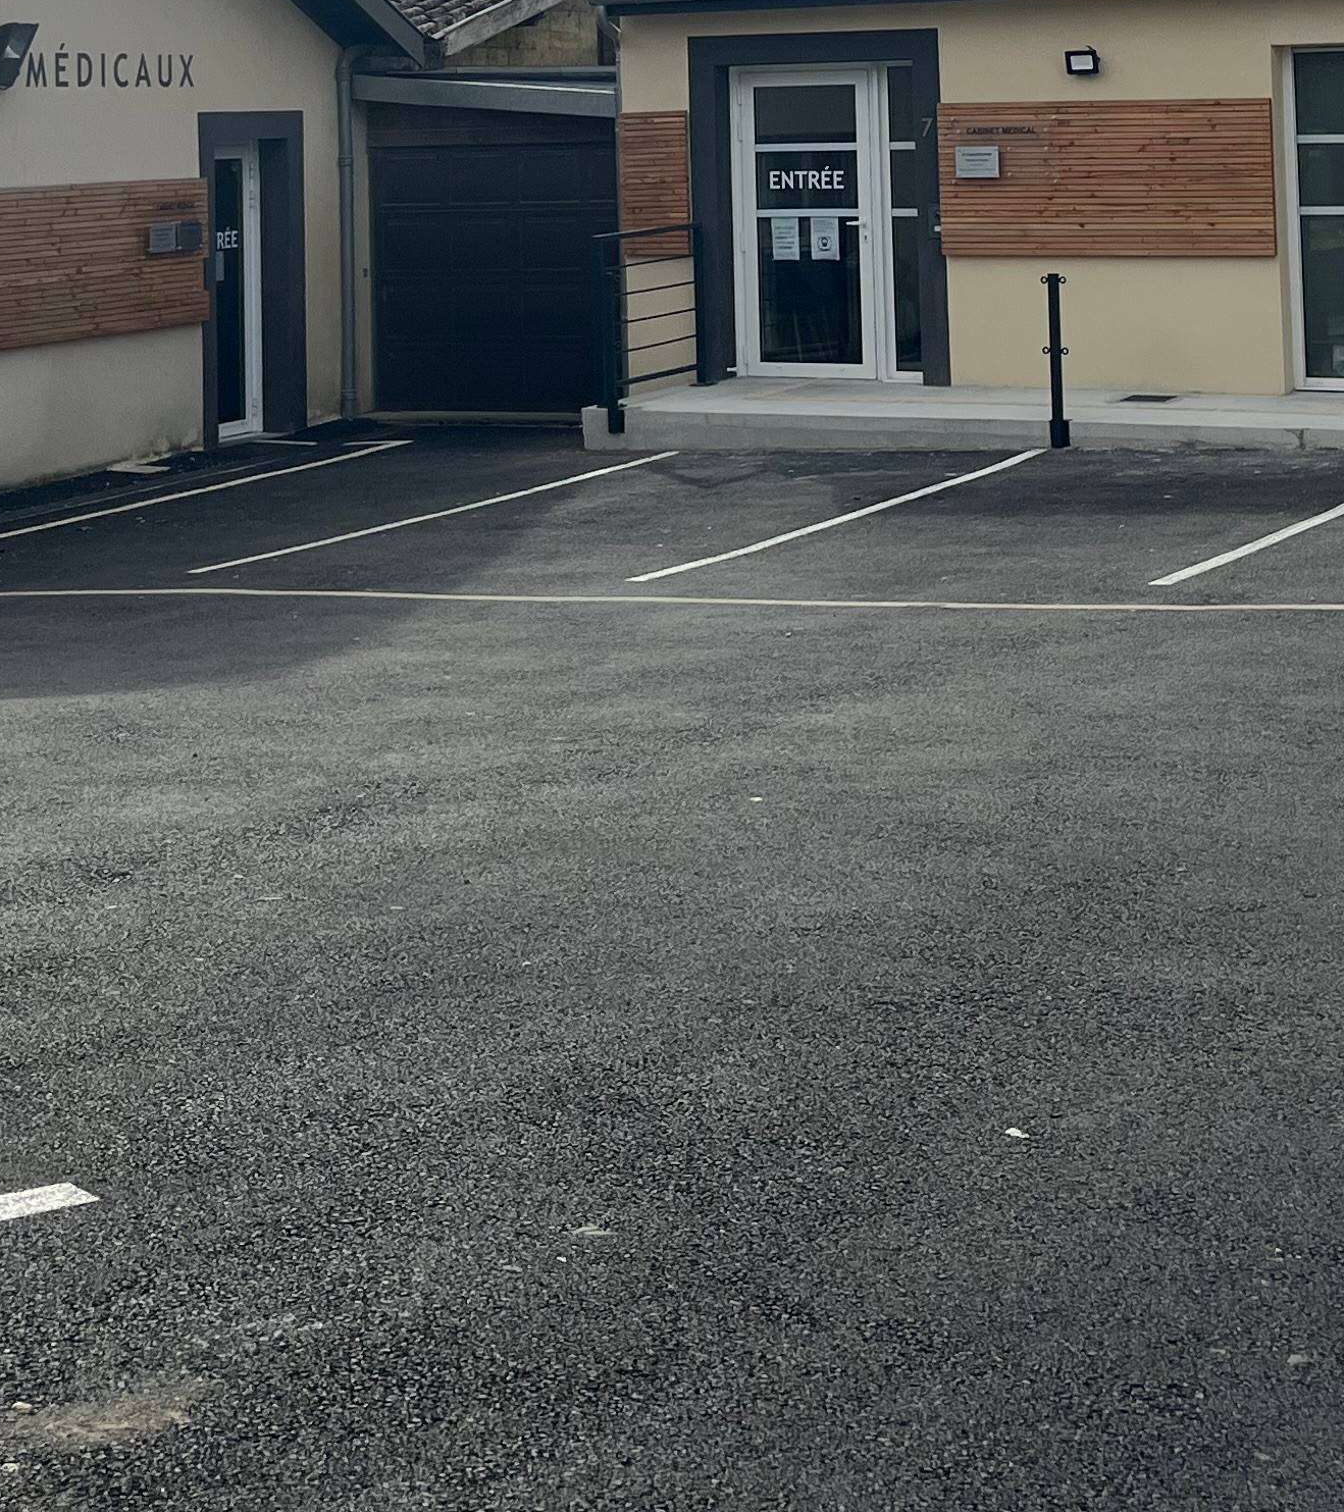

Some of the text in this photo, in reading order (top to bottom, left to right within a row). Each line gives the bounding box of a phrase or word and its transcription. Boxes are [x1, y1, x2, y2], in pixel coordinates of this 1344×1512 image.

[25, 43, 195, 88] MÉDICAUX
[921, 117, 933, 137] 7
[769, 165, 845, 190] ENTRÉE
[216, 226, 239, 250] RÉE
